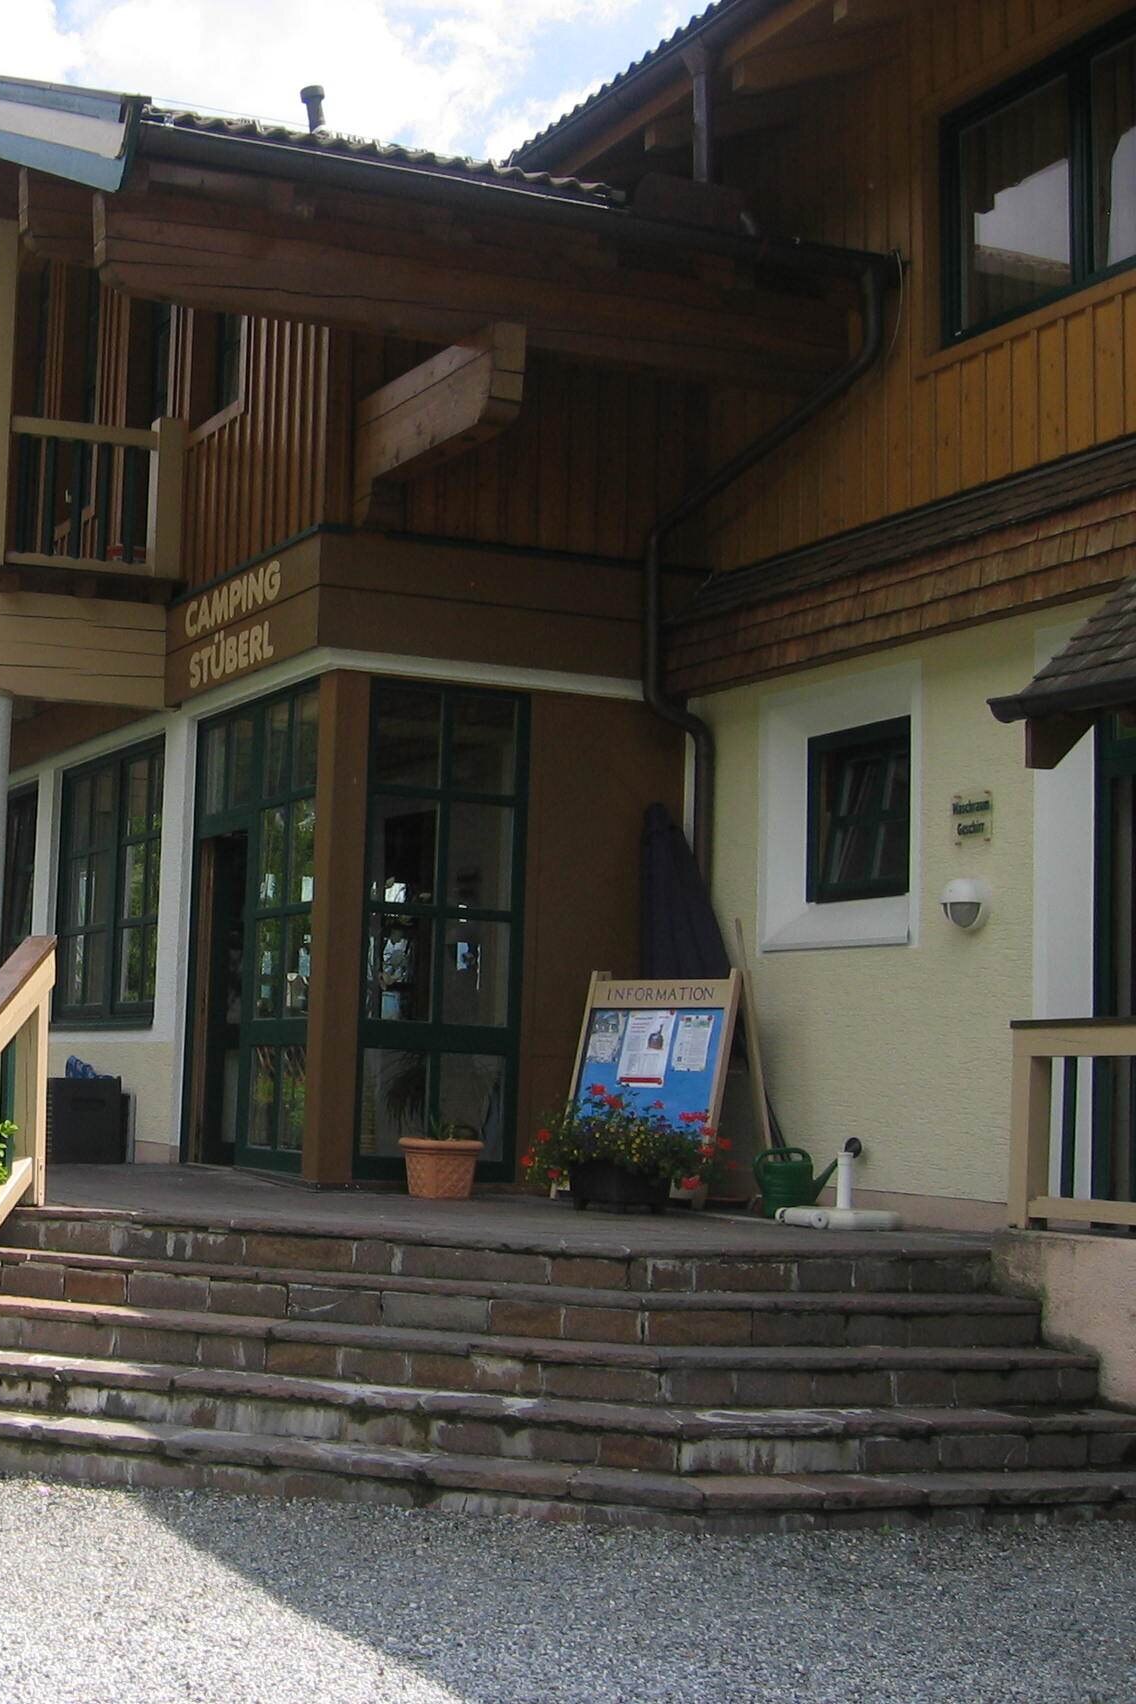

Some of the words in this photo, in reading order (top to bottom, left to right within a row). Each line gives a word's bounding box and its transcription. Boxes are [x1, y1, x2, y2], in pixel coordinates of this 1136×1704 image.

[185, 560, 280, 637] CAMPING
[189, 620, 273, 688] STÜBERL
[607, 986, 715, 1001] INFORMATION
